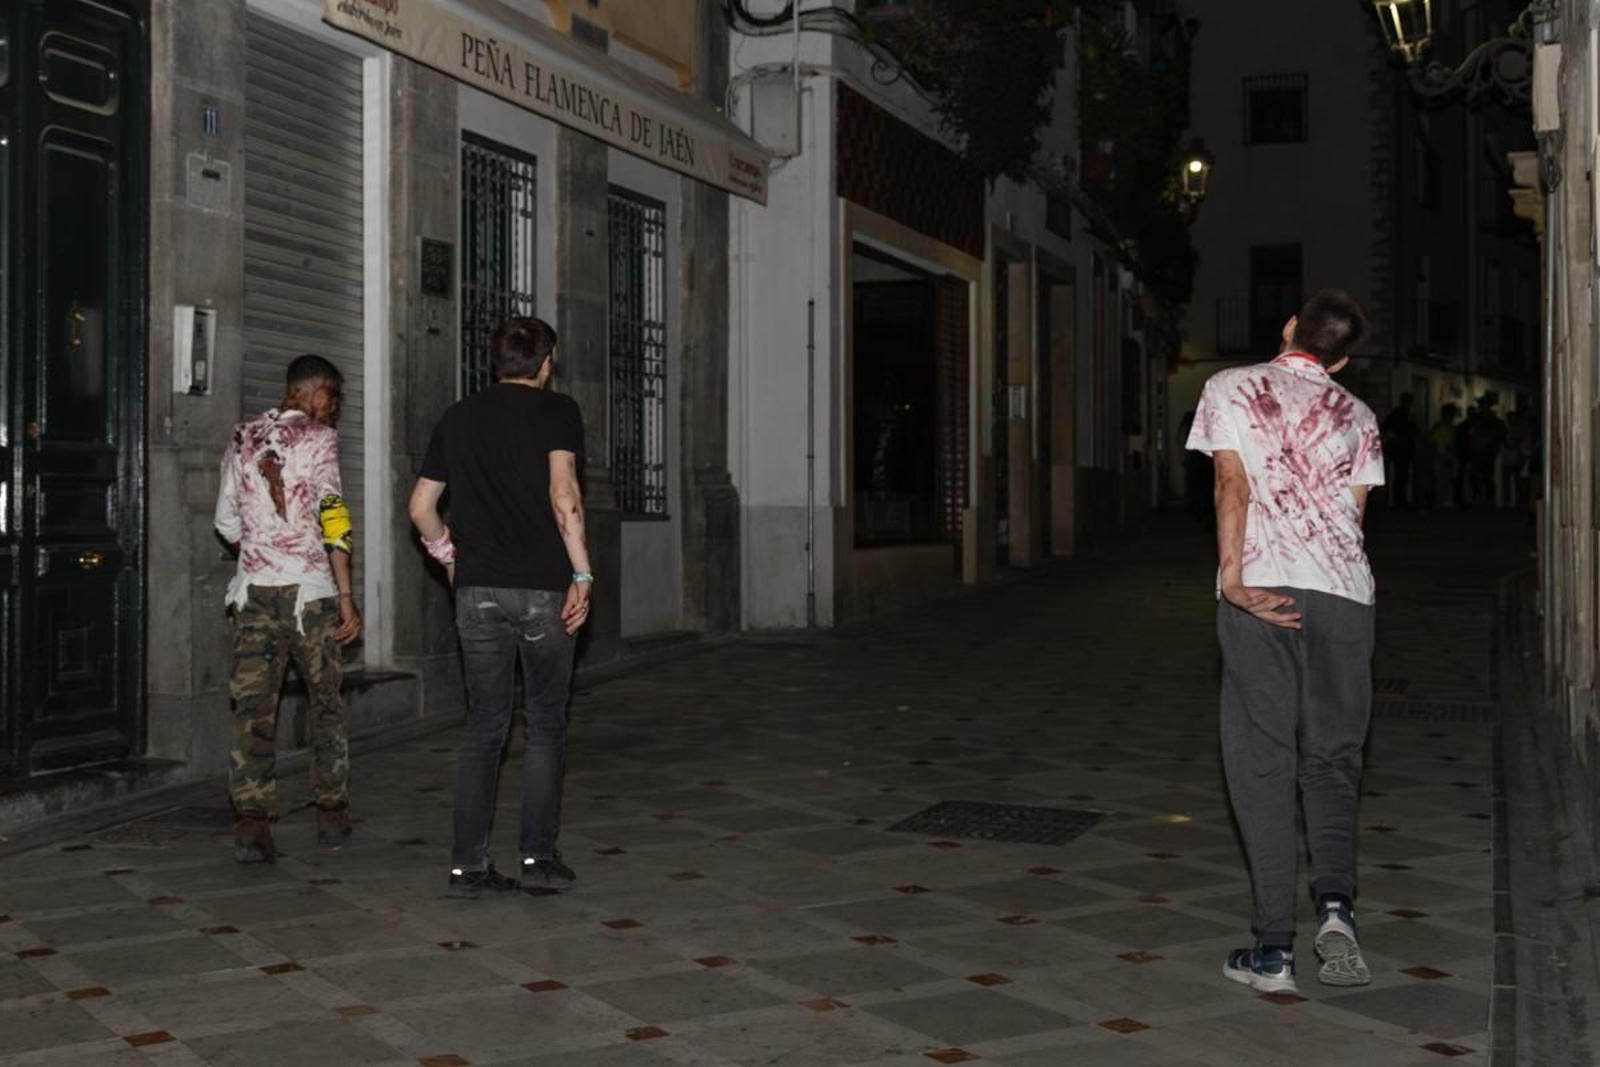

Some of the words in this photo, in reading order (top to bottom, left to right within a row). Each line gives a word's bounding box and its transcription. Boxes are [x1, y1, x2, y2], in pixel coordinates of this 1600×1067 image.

[461, 32, 515, 90] PEÑA
[524, 62, 623, 137] FLAMENCA
[630, 110, 651, 148] DE
[659, 123, 694, 166] JAÉN
